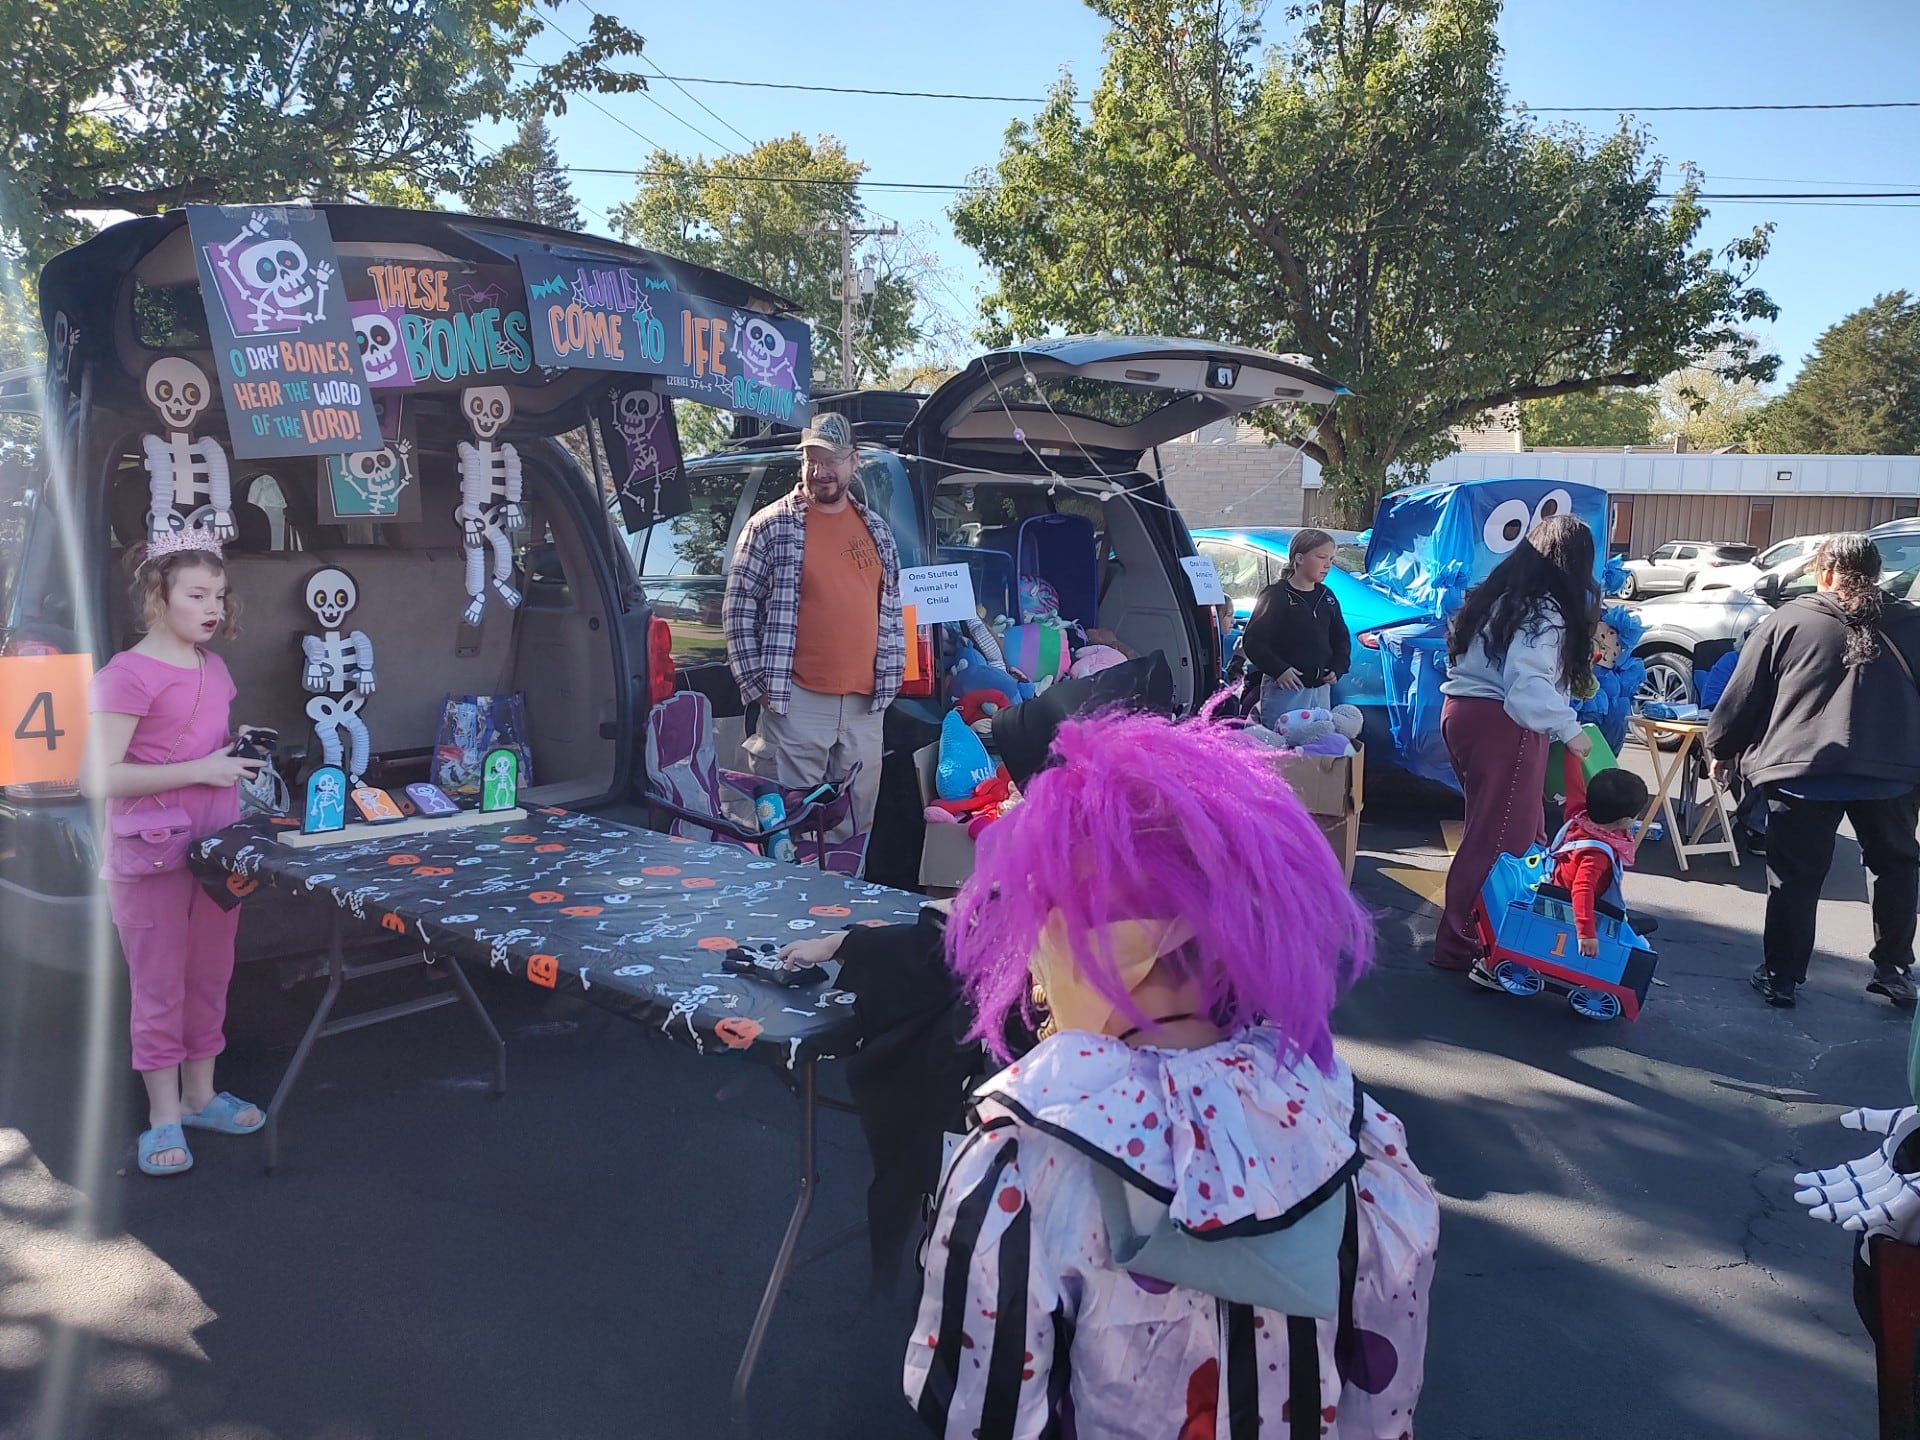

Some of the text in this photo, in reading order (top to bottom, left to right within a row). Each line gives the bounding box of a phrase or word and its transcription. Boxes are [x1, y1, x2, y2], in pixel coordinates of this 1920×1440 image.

[367, 265, 450, 312] THESE
[576, 268, 636, 312] WILL
[399, 308, 532, 384] BONES
[548, 304, 625, 360] COME
[632, 312, 666, 364] TO
[229, 341, 354, 378] O DRY BONES,
[233, 380, 361, 411] HEAR THE WORD
[666, 376, 689, 387] EZEKIEL
[732, 375, 793, 421] AGAIN
[251, 409, 362, 444] OF THE LORD!
[908, 569, 958, 581] One Stuffed
[913, 584, 943, 593] Animal
[926, 596, 949, 605] Child
[14, 691, 65, 751] 4
[1550, 933, 1568, 958] 1
